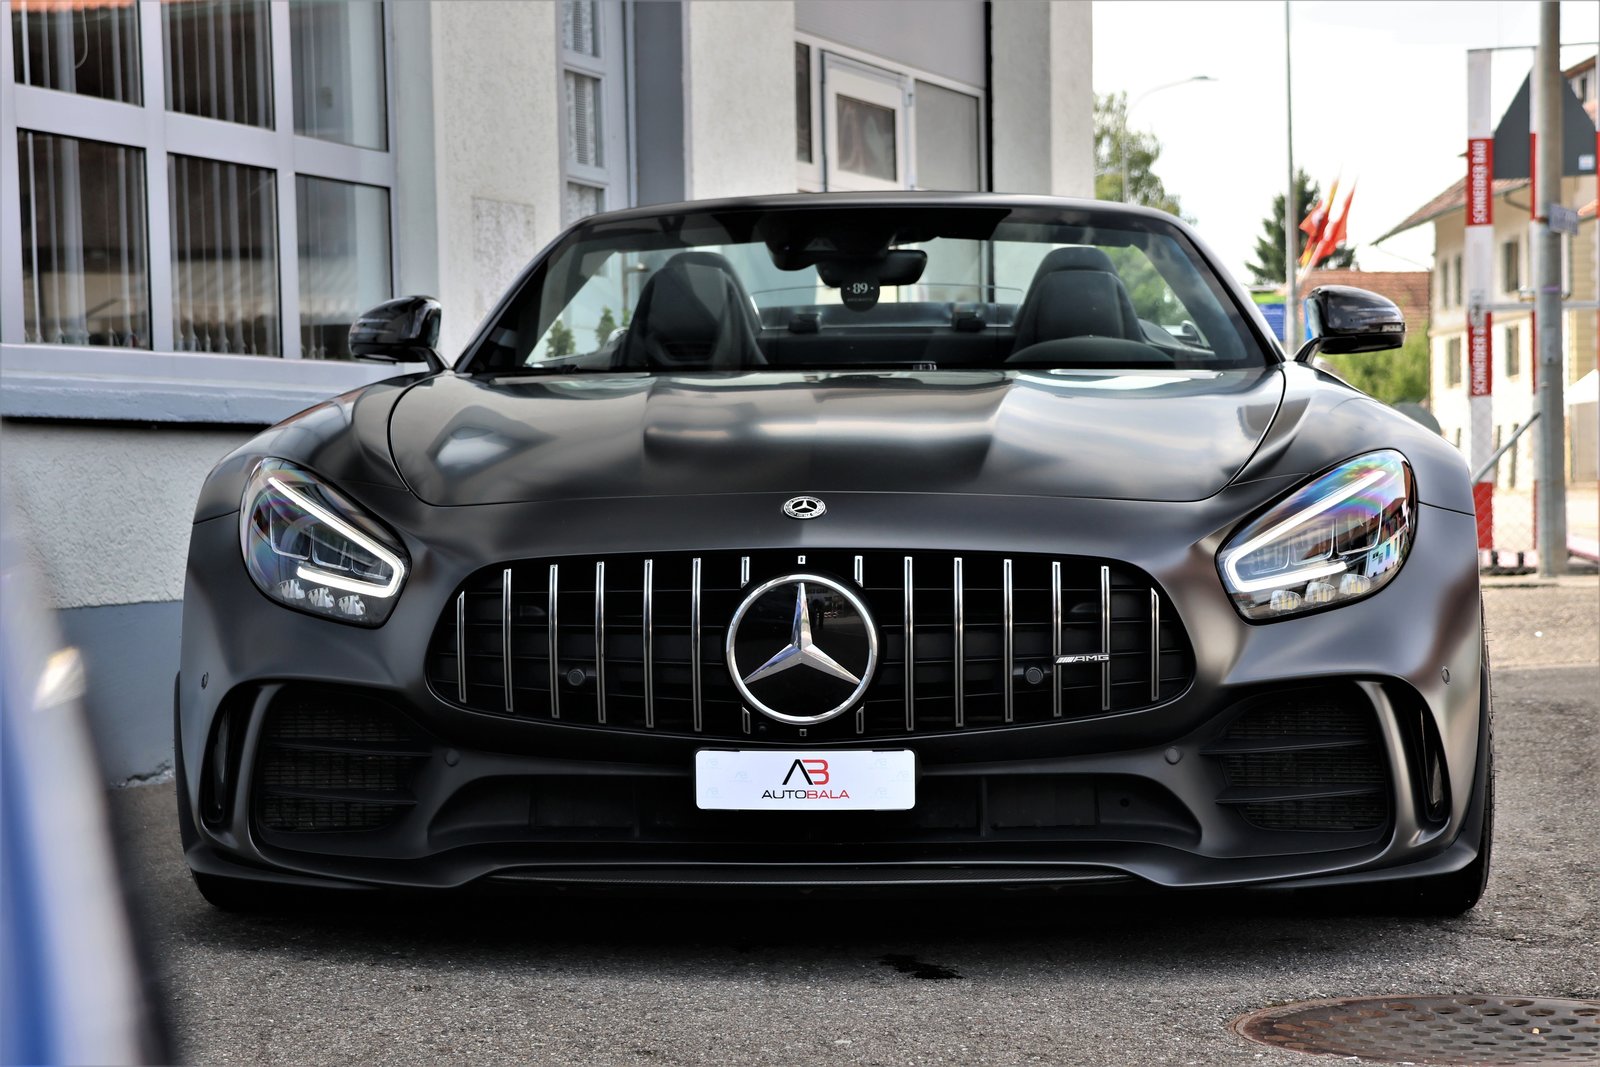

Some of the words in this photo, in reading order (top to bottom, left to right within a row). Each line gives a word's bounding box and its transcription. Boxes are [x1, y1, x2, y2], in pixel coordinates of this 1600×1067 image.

[1472, 141, 1487, 164] BAU
[1472, 165, 1487, 224] SCHNEIDER
[1473, 336, 1487, 395] SCHNEIDER
[761, 789, 850, 799] AUTOBALA
